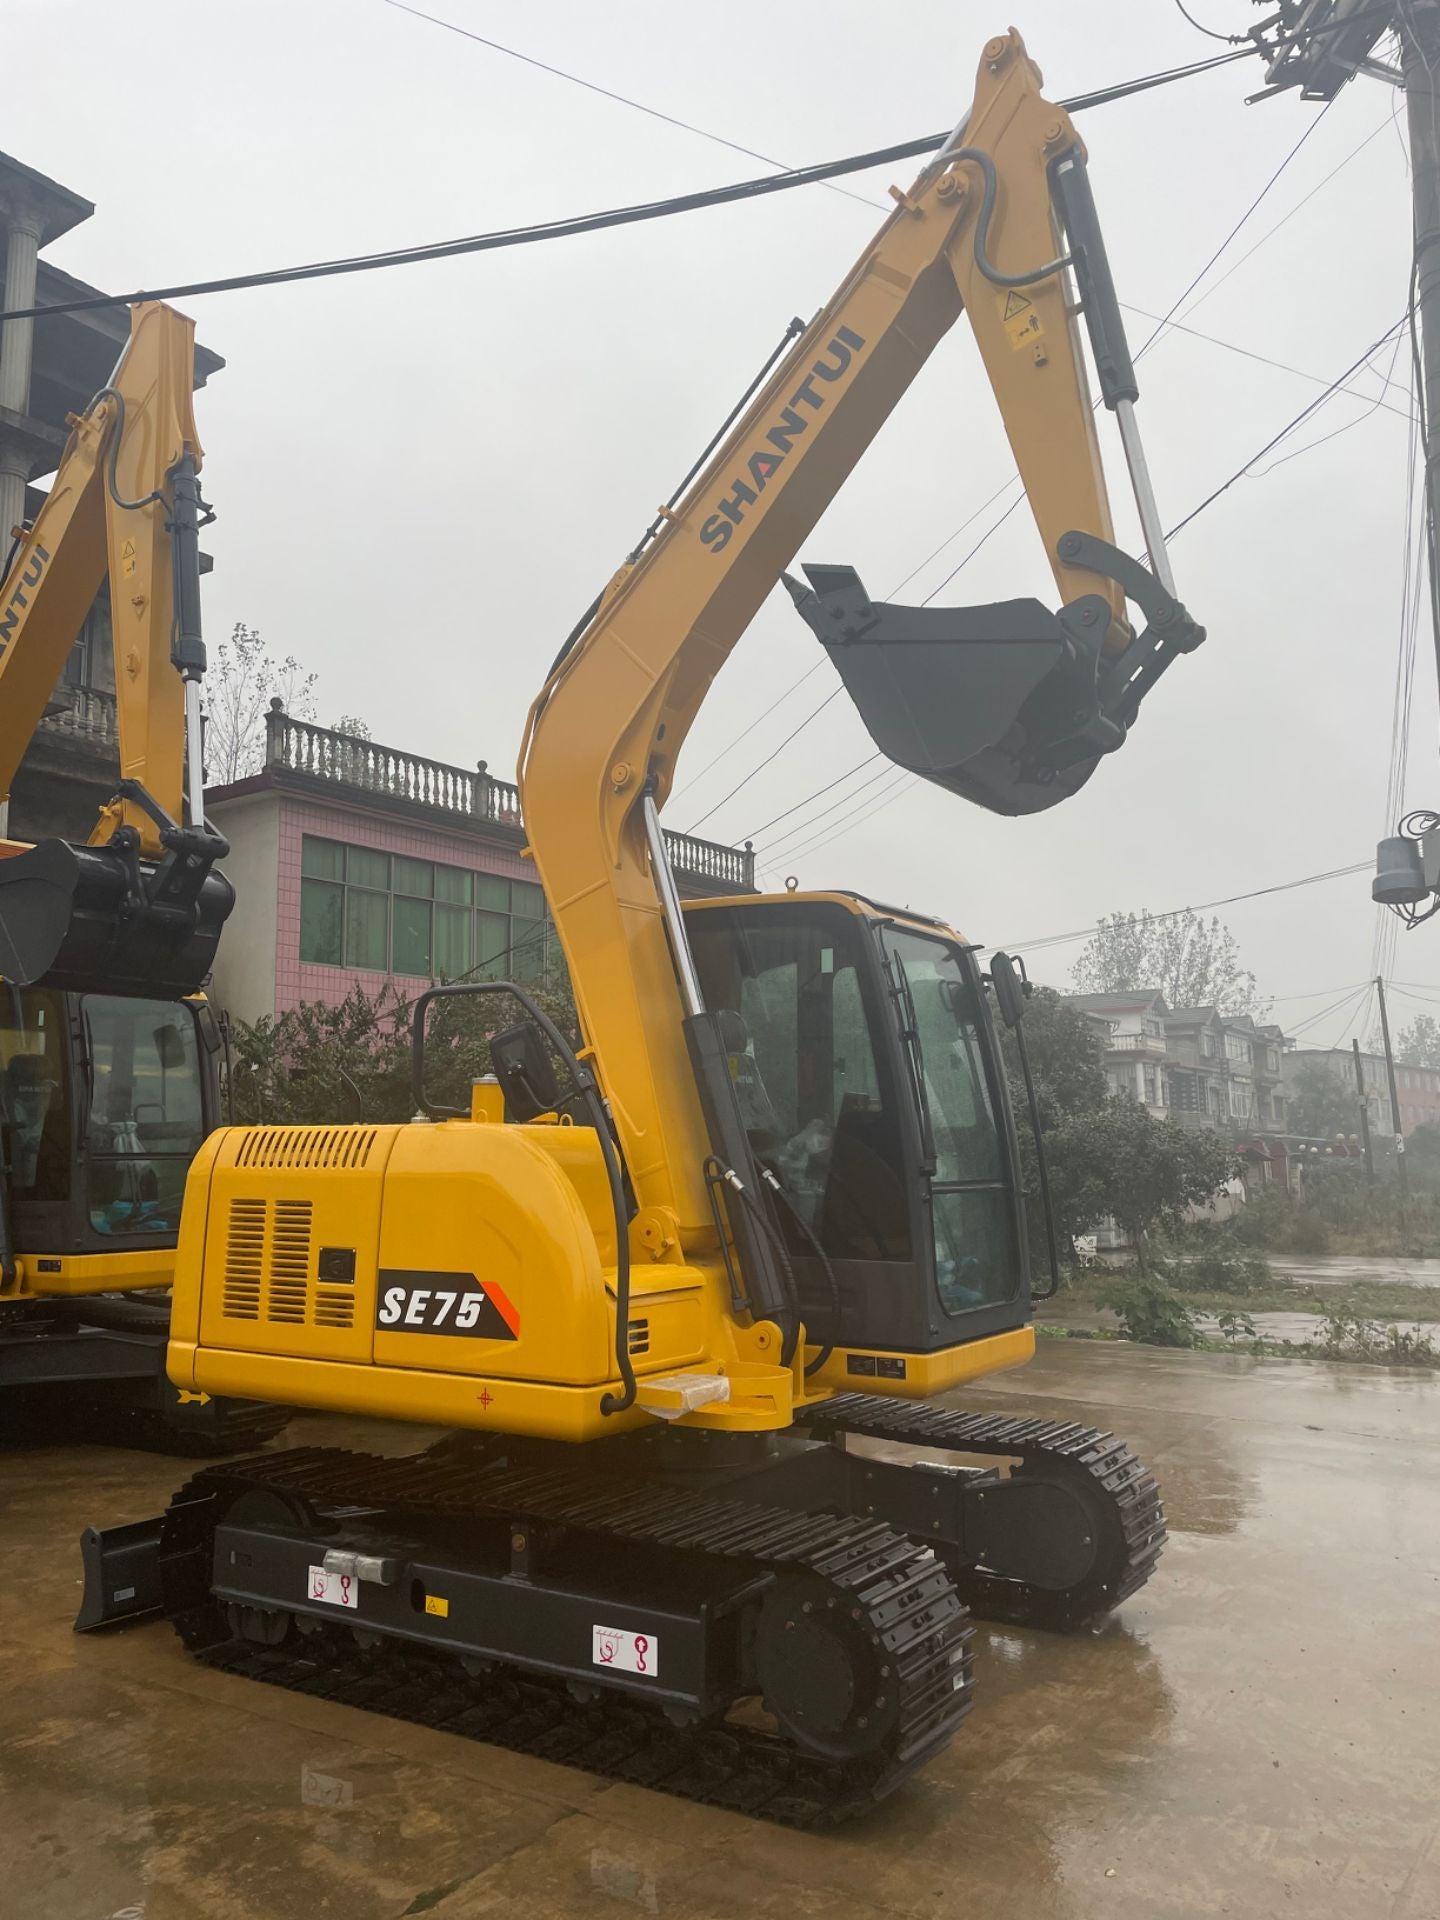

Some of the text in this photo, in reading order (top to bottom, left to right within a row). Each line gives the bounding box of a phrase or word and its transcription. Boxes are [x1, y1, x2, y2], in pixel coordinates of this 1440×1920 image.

[700, 325, 866, 553] SHANTUI
[0, 544, 50, 658] NTUI
[378, 1287, 485, 1328] SE75
